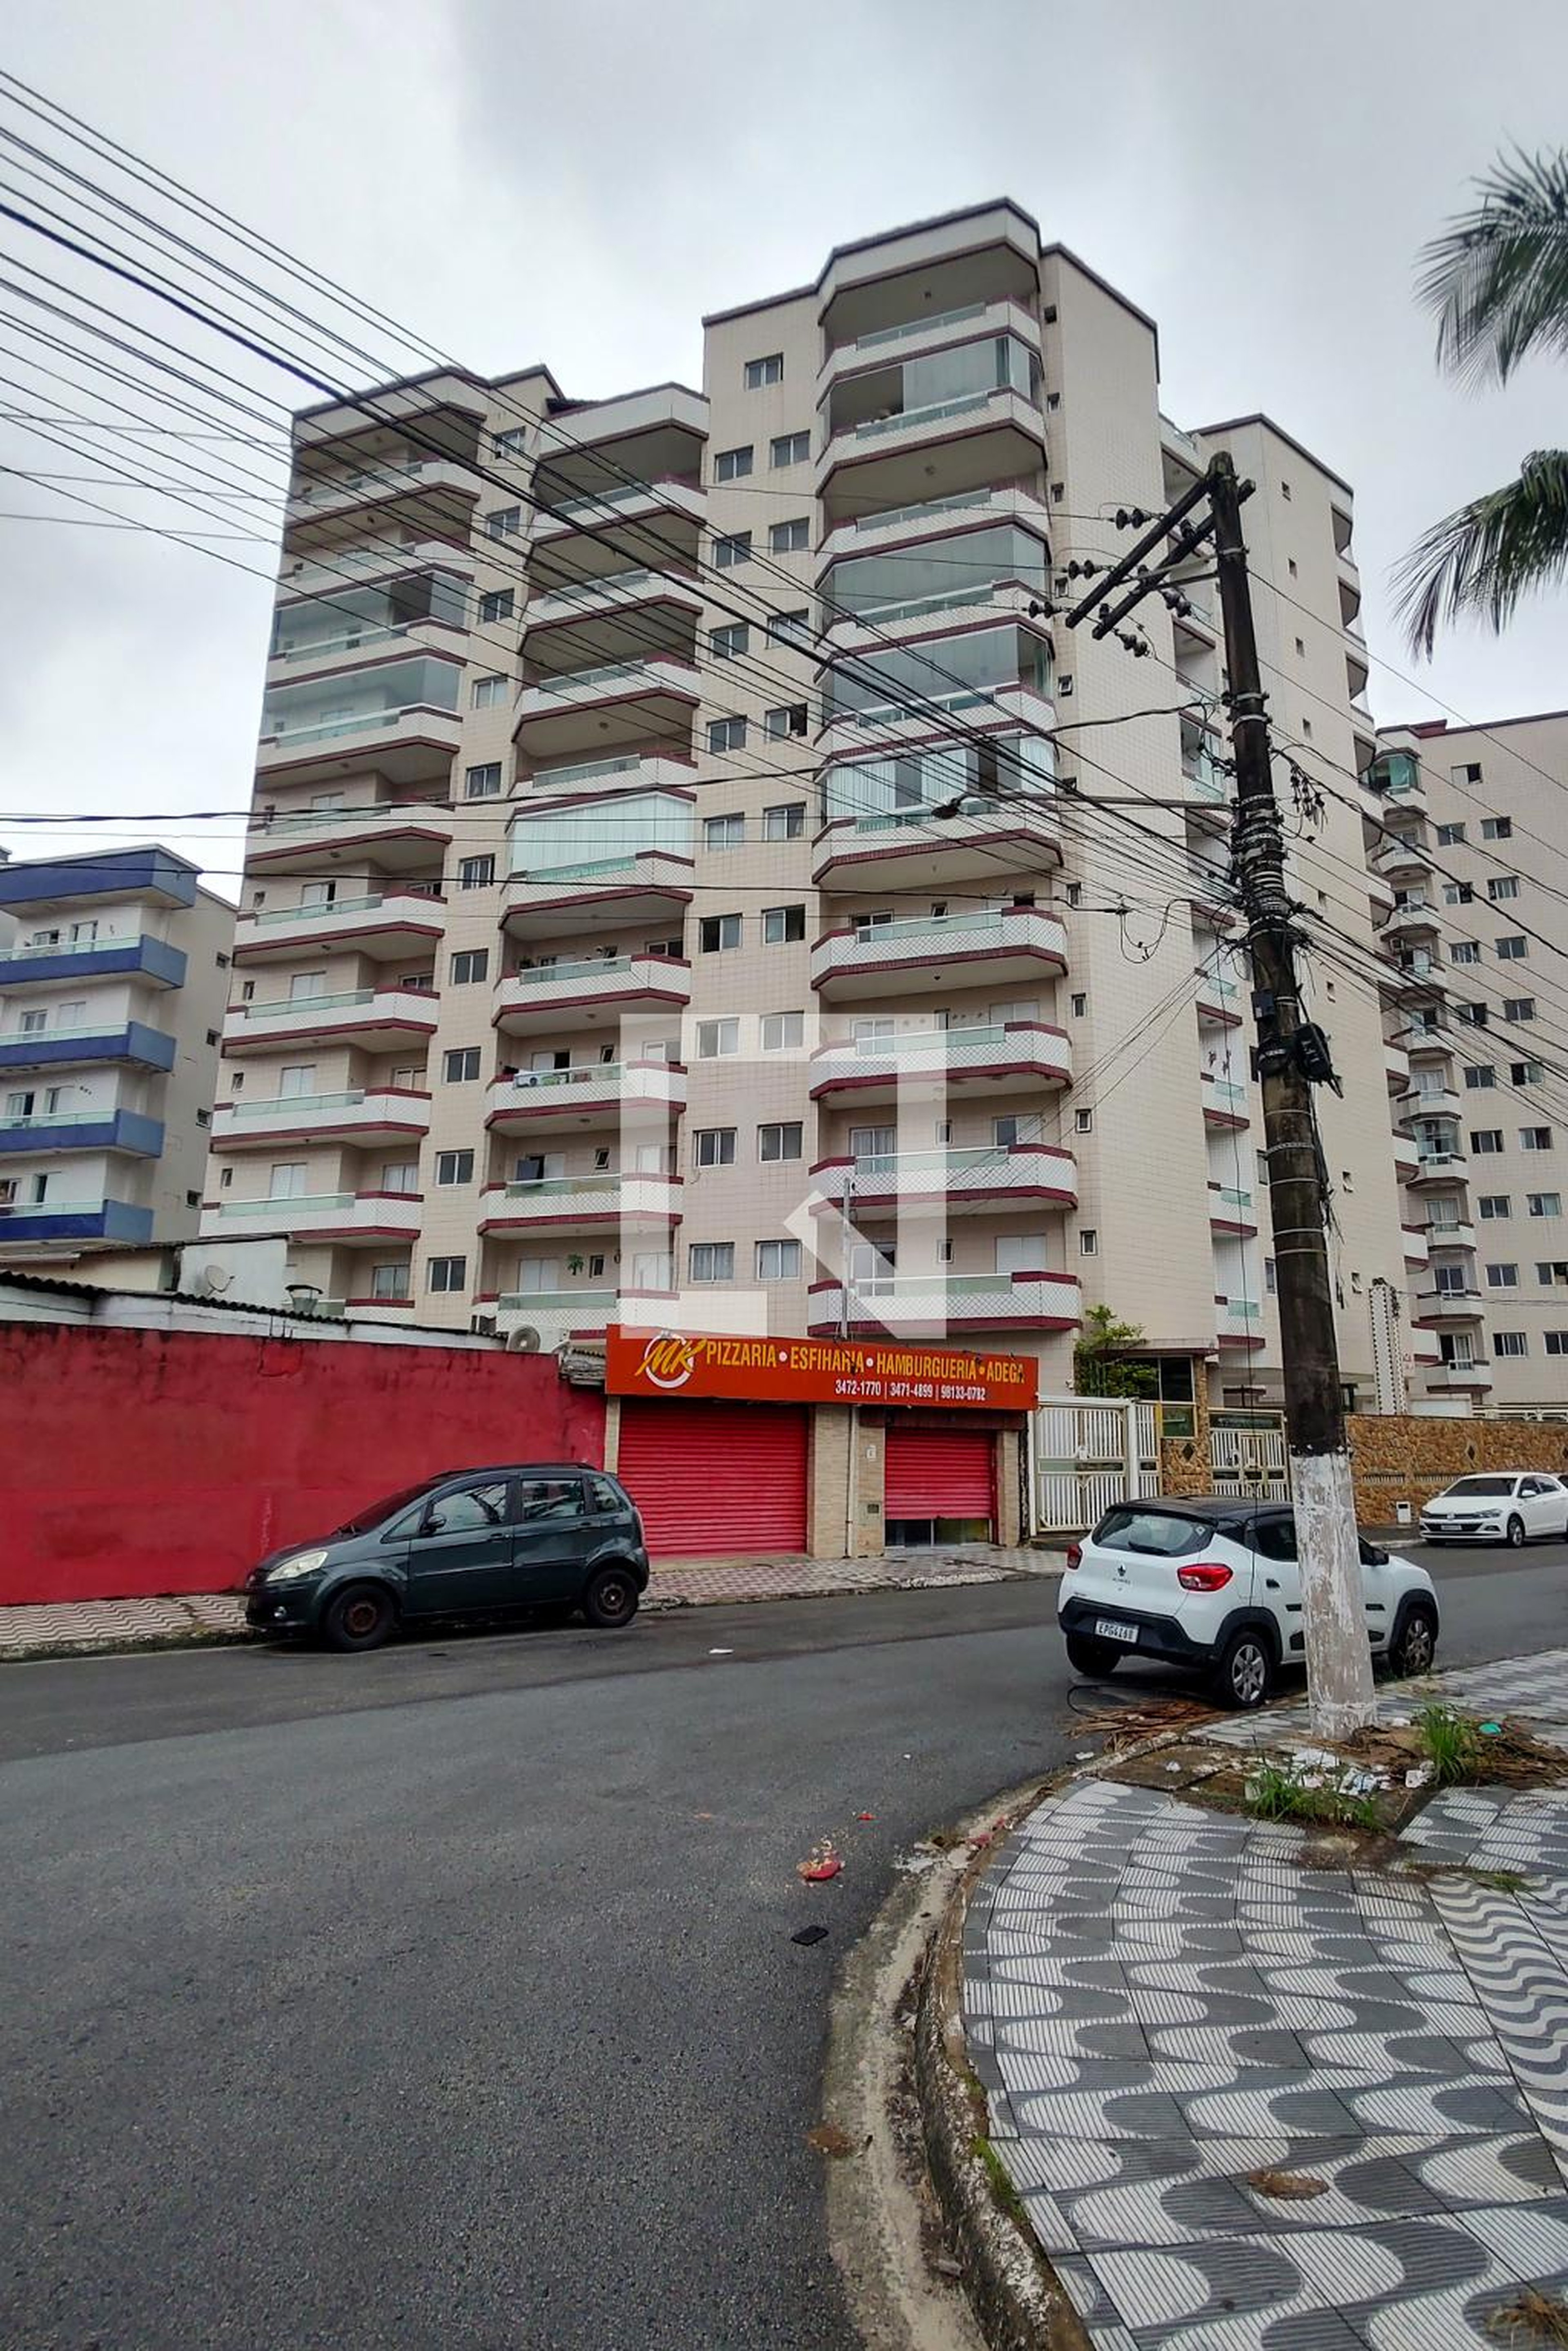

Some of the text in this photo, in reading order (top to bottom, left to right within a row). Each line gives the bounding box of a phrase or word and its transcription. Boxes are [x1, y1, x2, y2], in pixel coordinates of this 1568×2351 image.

[706, 1341, 777, 1367] PIZZARIA
[877, 1352, 977, 1380] HAMBURGUERIA
[986, 1361, 1025, 1383] ADEGA
[835, 1379, 881, 1396] 3472-1770
